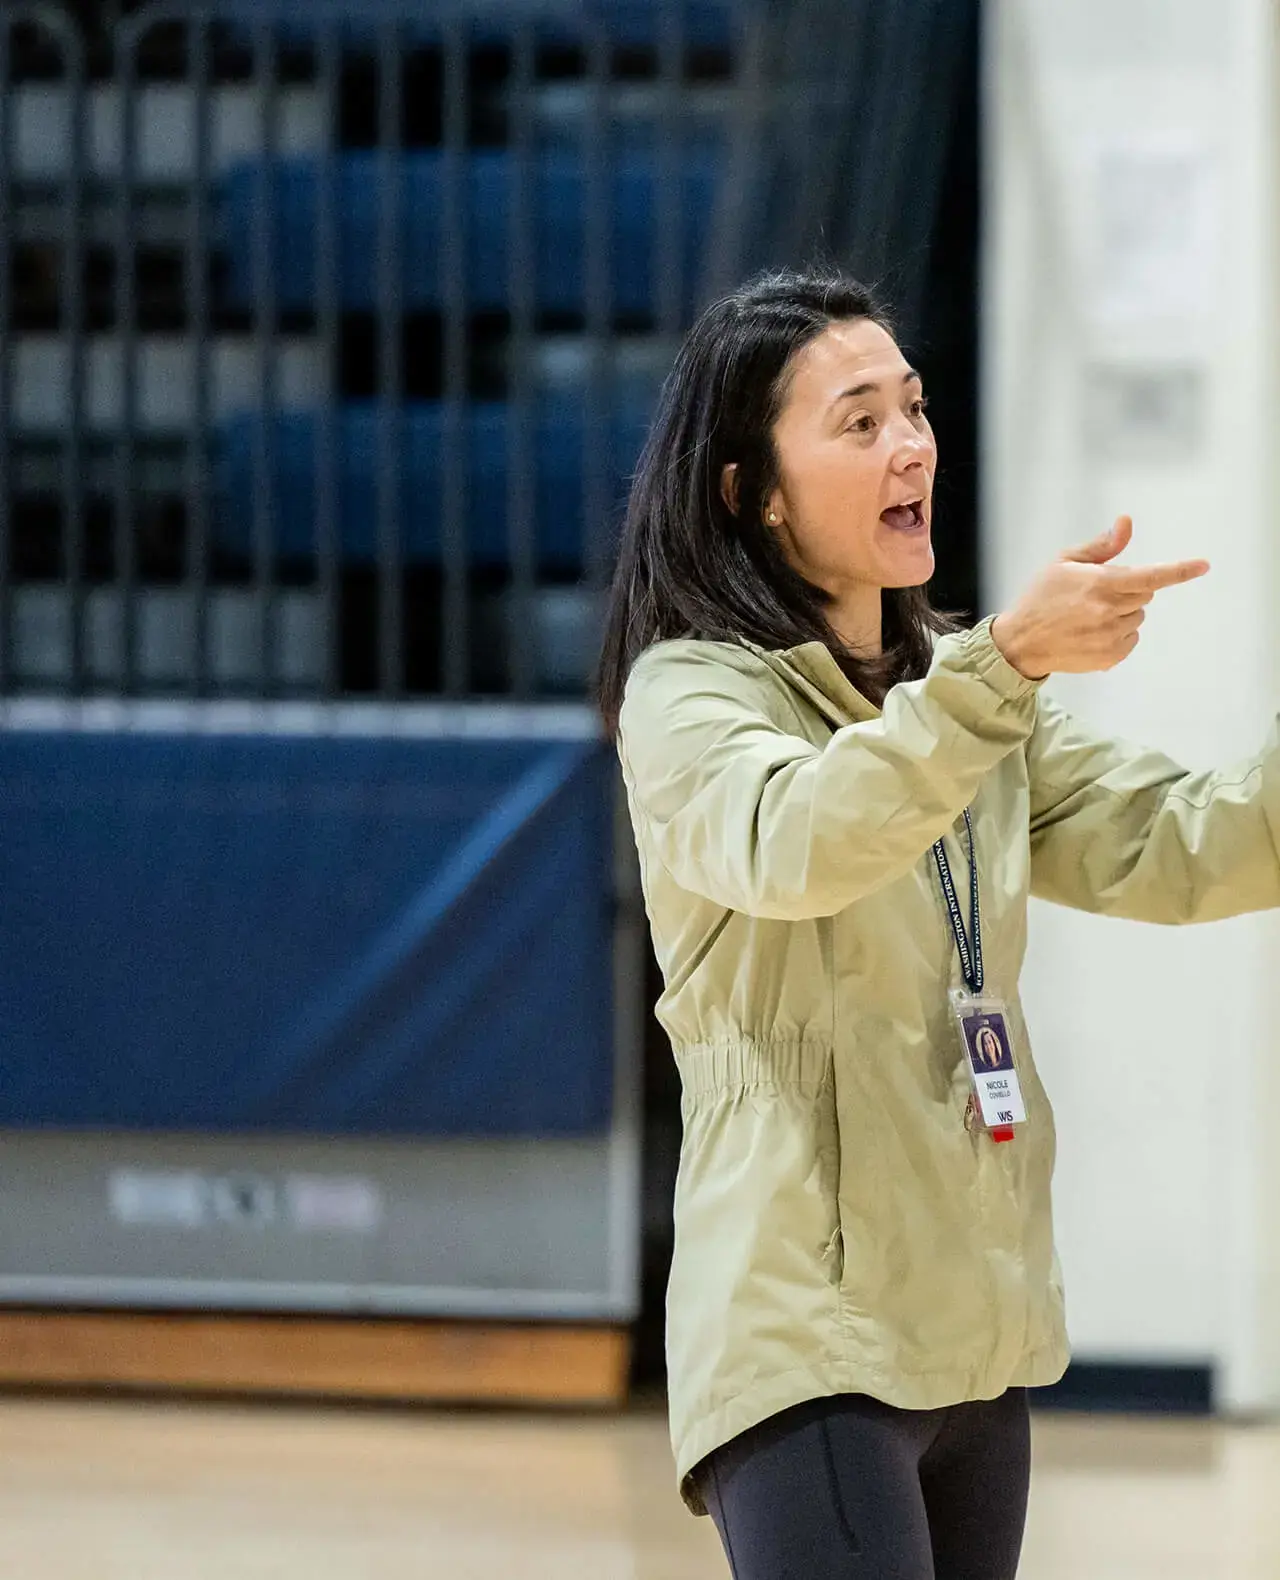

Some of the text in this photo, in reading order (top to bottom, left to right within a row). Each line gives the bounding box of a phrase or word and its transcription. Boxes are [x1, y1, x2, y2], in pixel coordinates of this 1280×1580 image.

[951, 914, 973, 979] WASHINGTON
[986, 1080, 1009, 1090] NICOLE
[997, 1110, 1014, 1122] WIS
